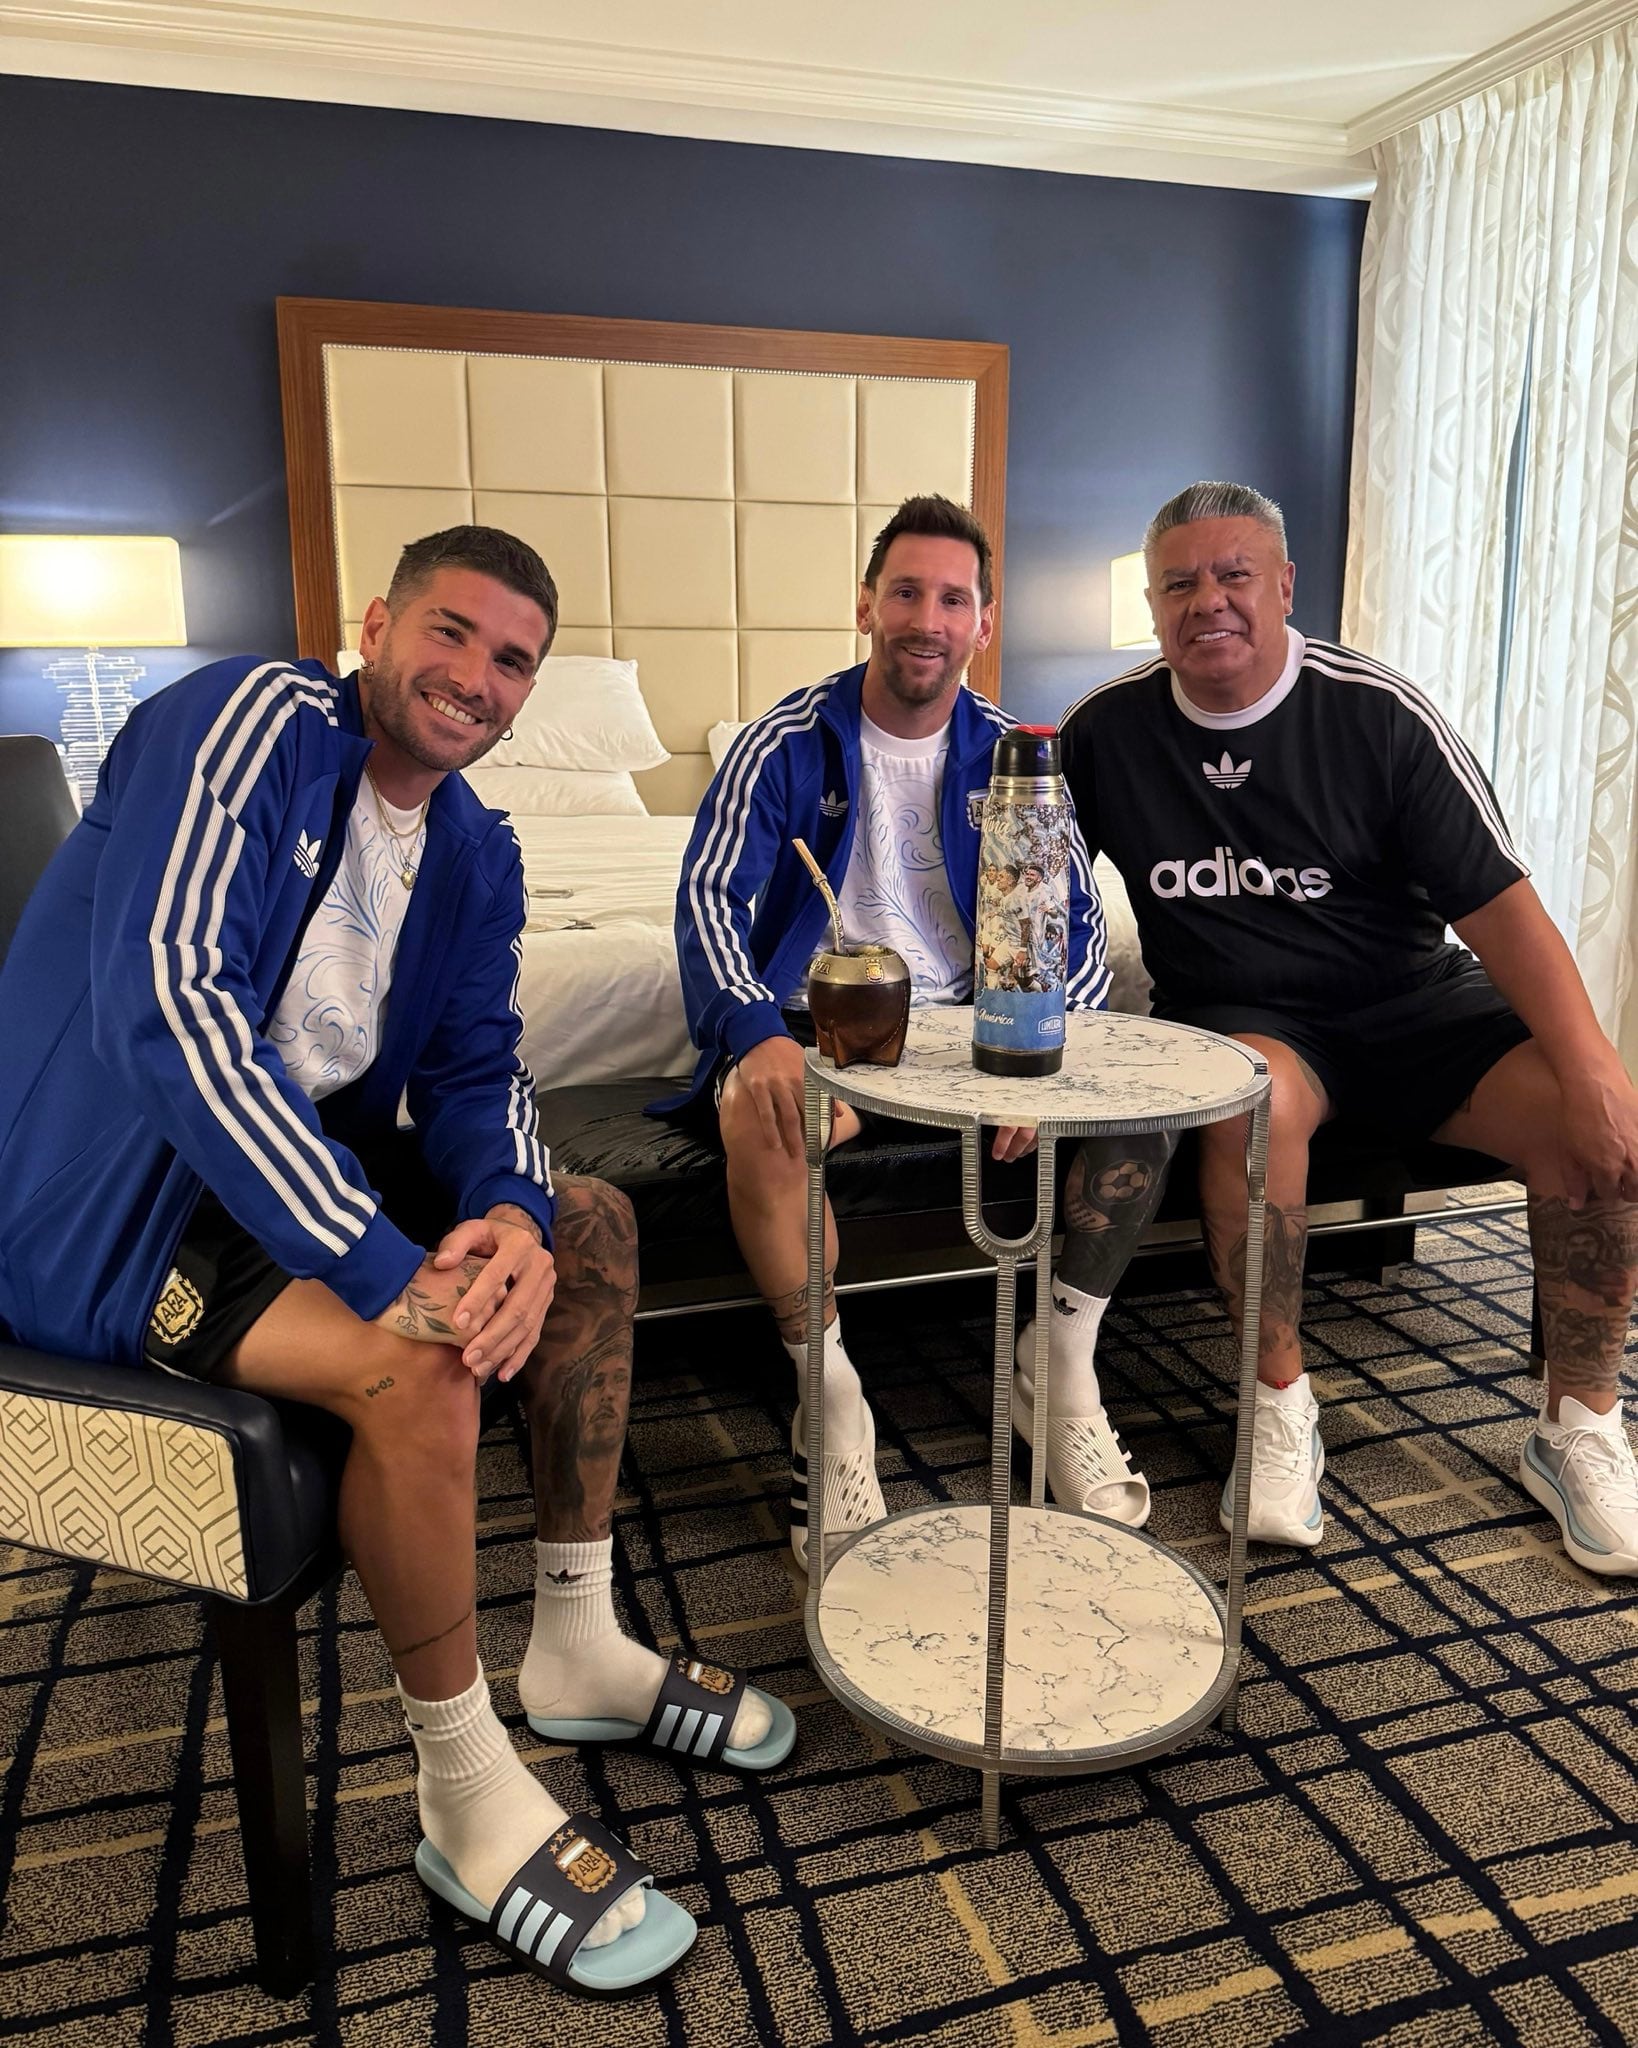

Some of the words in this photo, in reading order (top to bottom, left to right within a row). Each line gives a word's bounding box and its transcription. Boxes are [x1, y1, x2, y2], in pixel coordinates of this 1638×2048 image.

[1149, 846, 1334, 902] adidas
[160, 1289, 188, 1324] AFA
[575, 1852, 601, 1877] AFA
